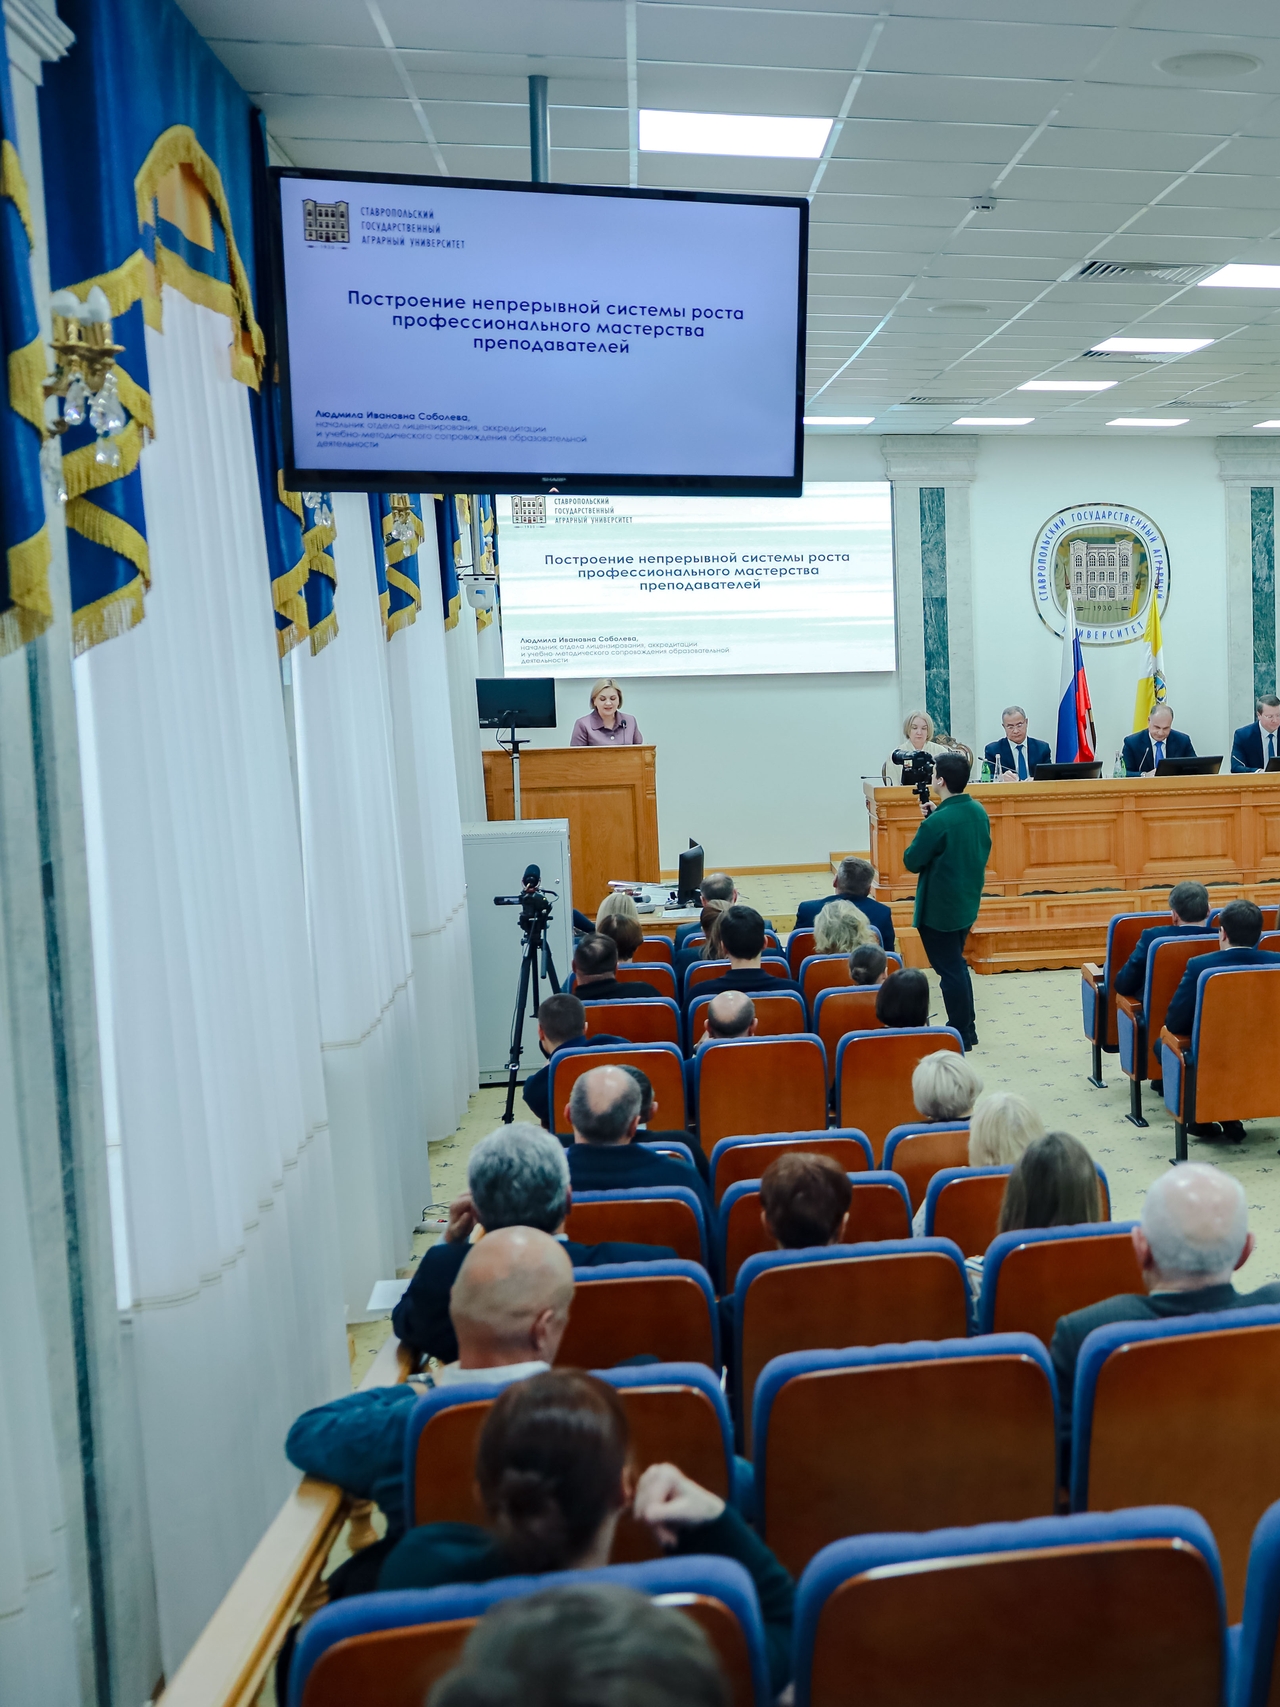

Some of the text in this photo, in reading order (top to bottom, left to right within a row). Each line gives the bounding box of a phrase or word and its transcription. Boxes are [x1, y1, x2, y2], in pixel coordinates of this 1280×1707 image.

[360, 206, 434, 219] СТАВРОПОЛЬСКИЙ
[361, 220, 441, 234] ГОСУДАРСТВЕННЫЙ
[361, 235, 465, 249] АГРАРНЫЙ УНИВЕРСИТЕТ
[348, 290, 744, 321] Построение непрерывной системы роста
[392, 313, 705, 339] профессионального мастерства
[473, 337, 629, 354] преподавателей
[315, 410, 470, 422] Людмила Ивановна Соболева,
[315, 421, 364, 429] начальник
[367, 422, 400, 430] отдела
[482, 425, 547, 433] аккредитации
[434, 433, 507, 441] сопровождения
[509, 433, 587, 443] образовательной
[554, 507, 614, 515] ГОСУДАРСТВЕННЫЙ
[555, 516, 633, 524] АГРАРНЫЙ УНИВЕРСИТЕТ
[544, 552, 850, 567] Построение непрерывной системы роста
[1037, 516, 1067, 601] СТАВРОПОЛЬСКИЙ
[1071, 510, 1158, 544] ГОСУДАРСТВЕННЫЙ
[578, 566, 819, 580] профессионального мастерства
[639, 578, 761, 592] преподавателей
[1062, 621, 1144, 640] ИВЕРСИТЕТ
[668, 647, 730, 655] образовательной
